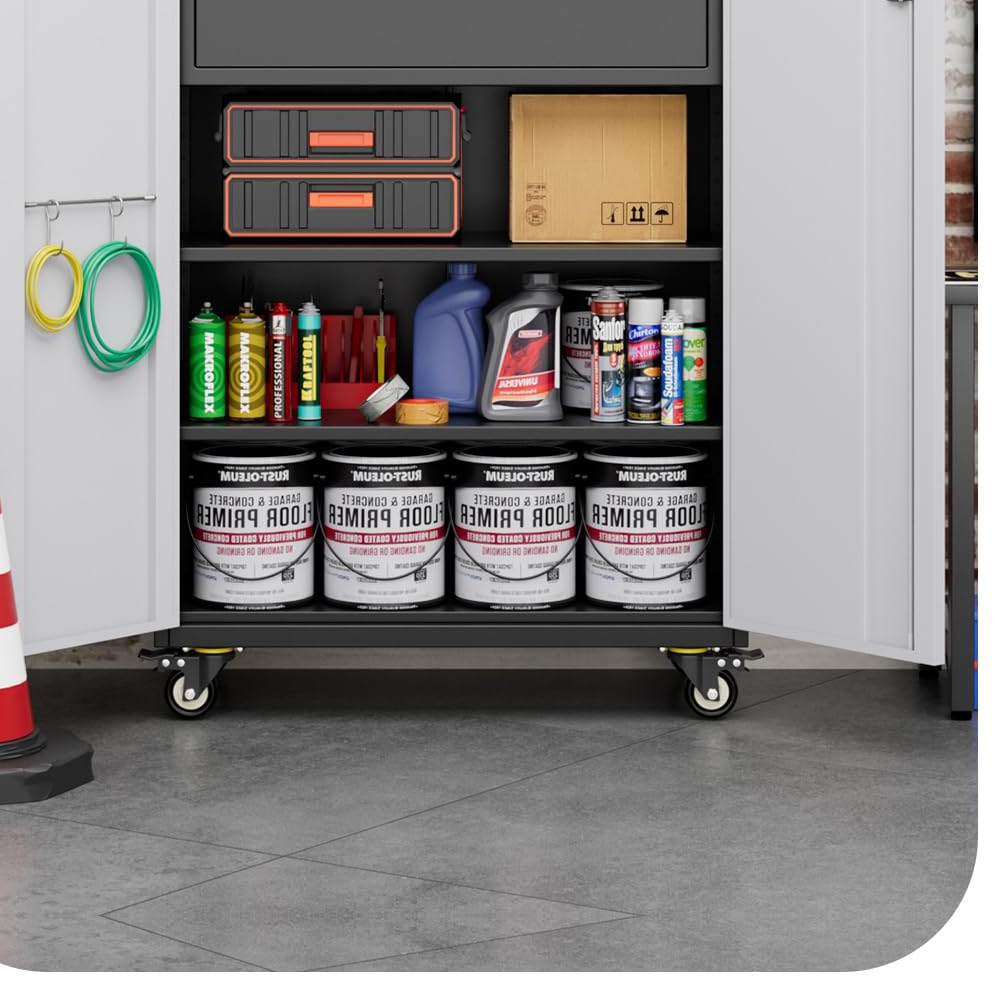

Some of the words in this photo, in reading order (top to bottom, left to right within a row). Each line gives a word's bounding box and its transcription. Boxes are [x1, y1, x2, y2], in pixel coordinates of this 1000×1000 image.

[301, 335, 313, 401] KRAFTOOL
[629, 326, 659, 340] Chirton
[663, 338, 673, 398] Soudafoam
[204, 332, 215, 413] MAKROFLEX
[240, 332, 250, 413] MAKROFLEX
[274, 341, 285, 418] PROFESSIONAL
